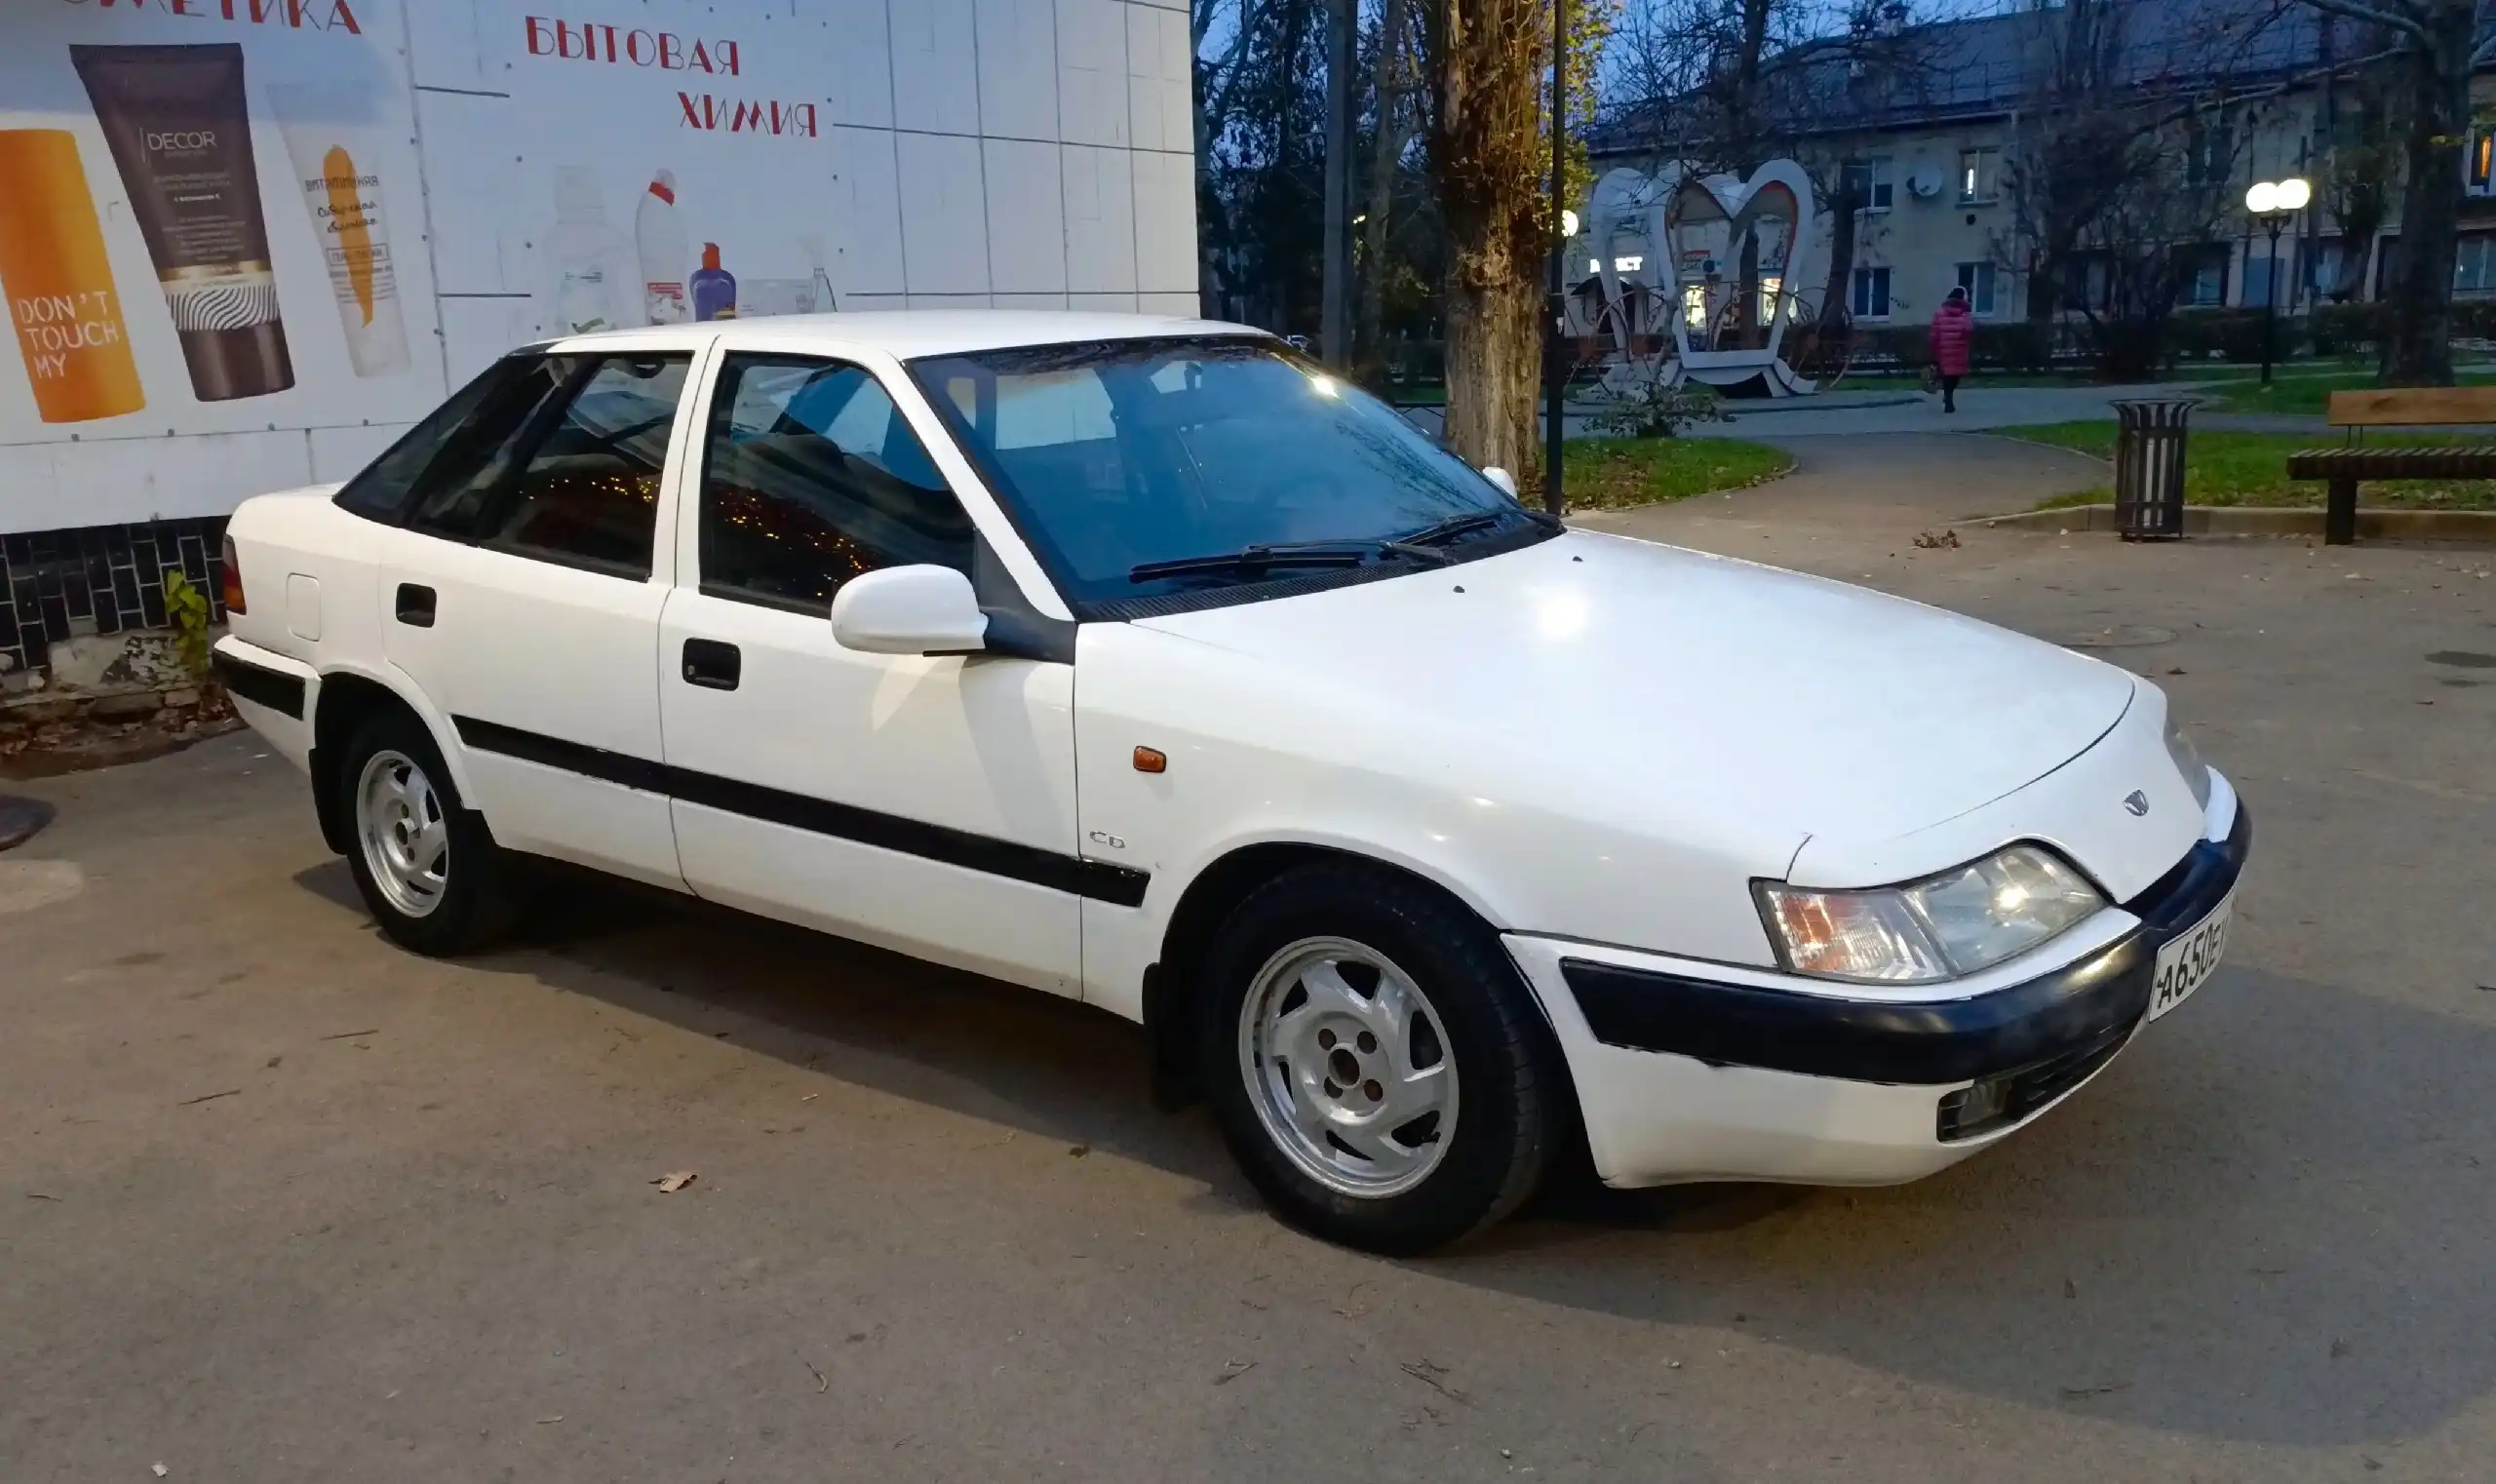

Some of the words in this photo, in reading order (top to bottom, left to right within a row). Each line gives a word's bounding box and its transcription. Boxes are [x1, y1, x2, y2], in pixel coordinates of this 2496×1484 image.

[526, 16, 739, 75] БЫТОВАЯ
[677, 92, 817, 137] ХИМИЯ
[147, 131, 217, 150] DECOR
[18, 291, 107, 324] DON'T
[23, 321, 119, 351] TOUCH
[33, 352, 66, 378] MY
